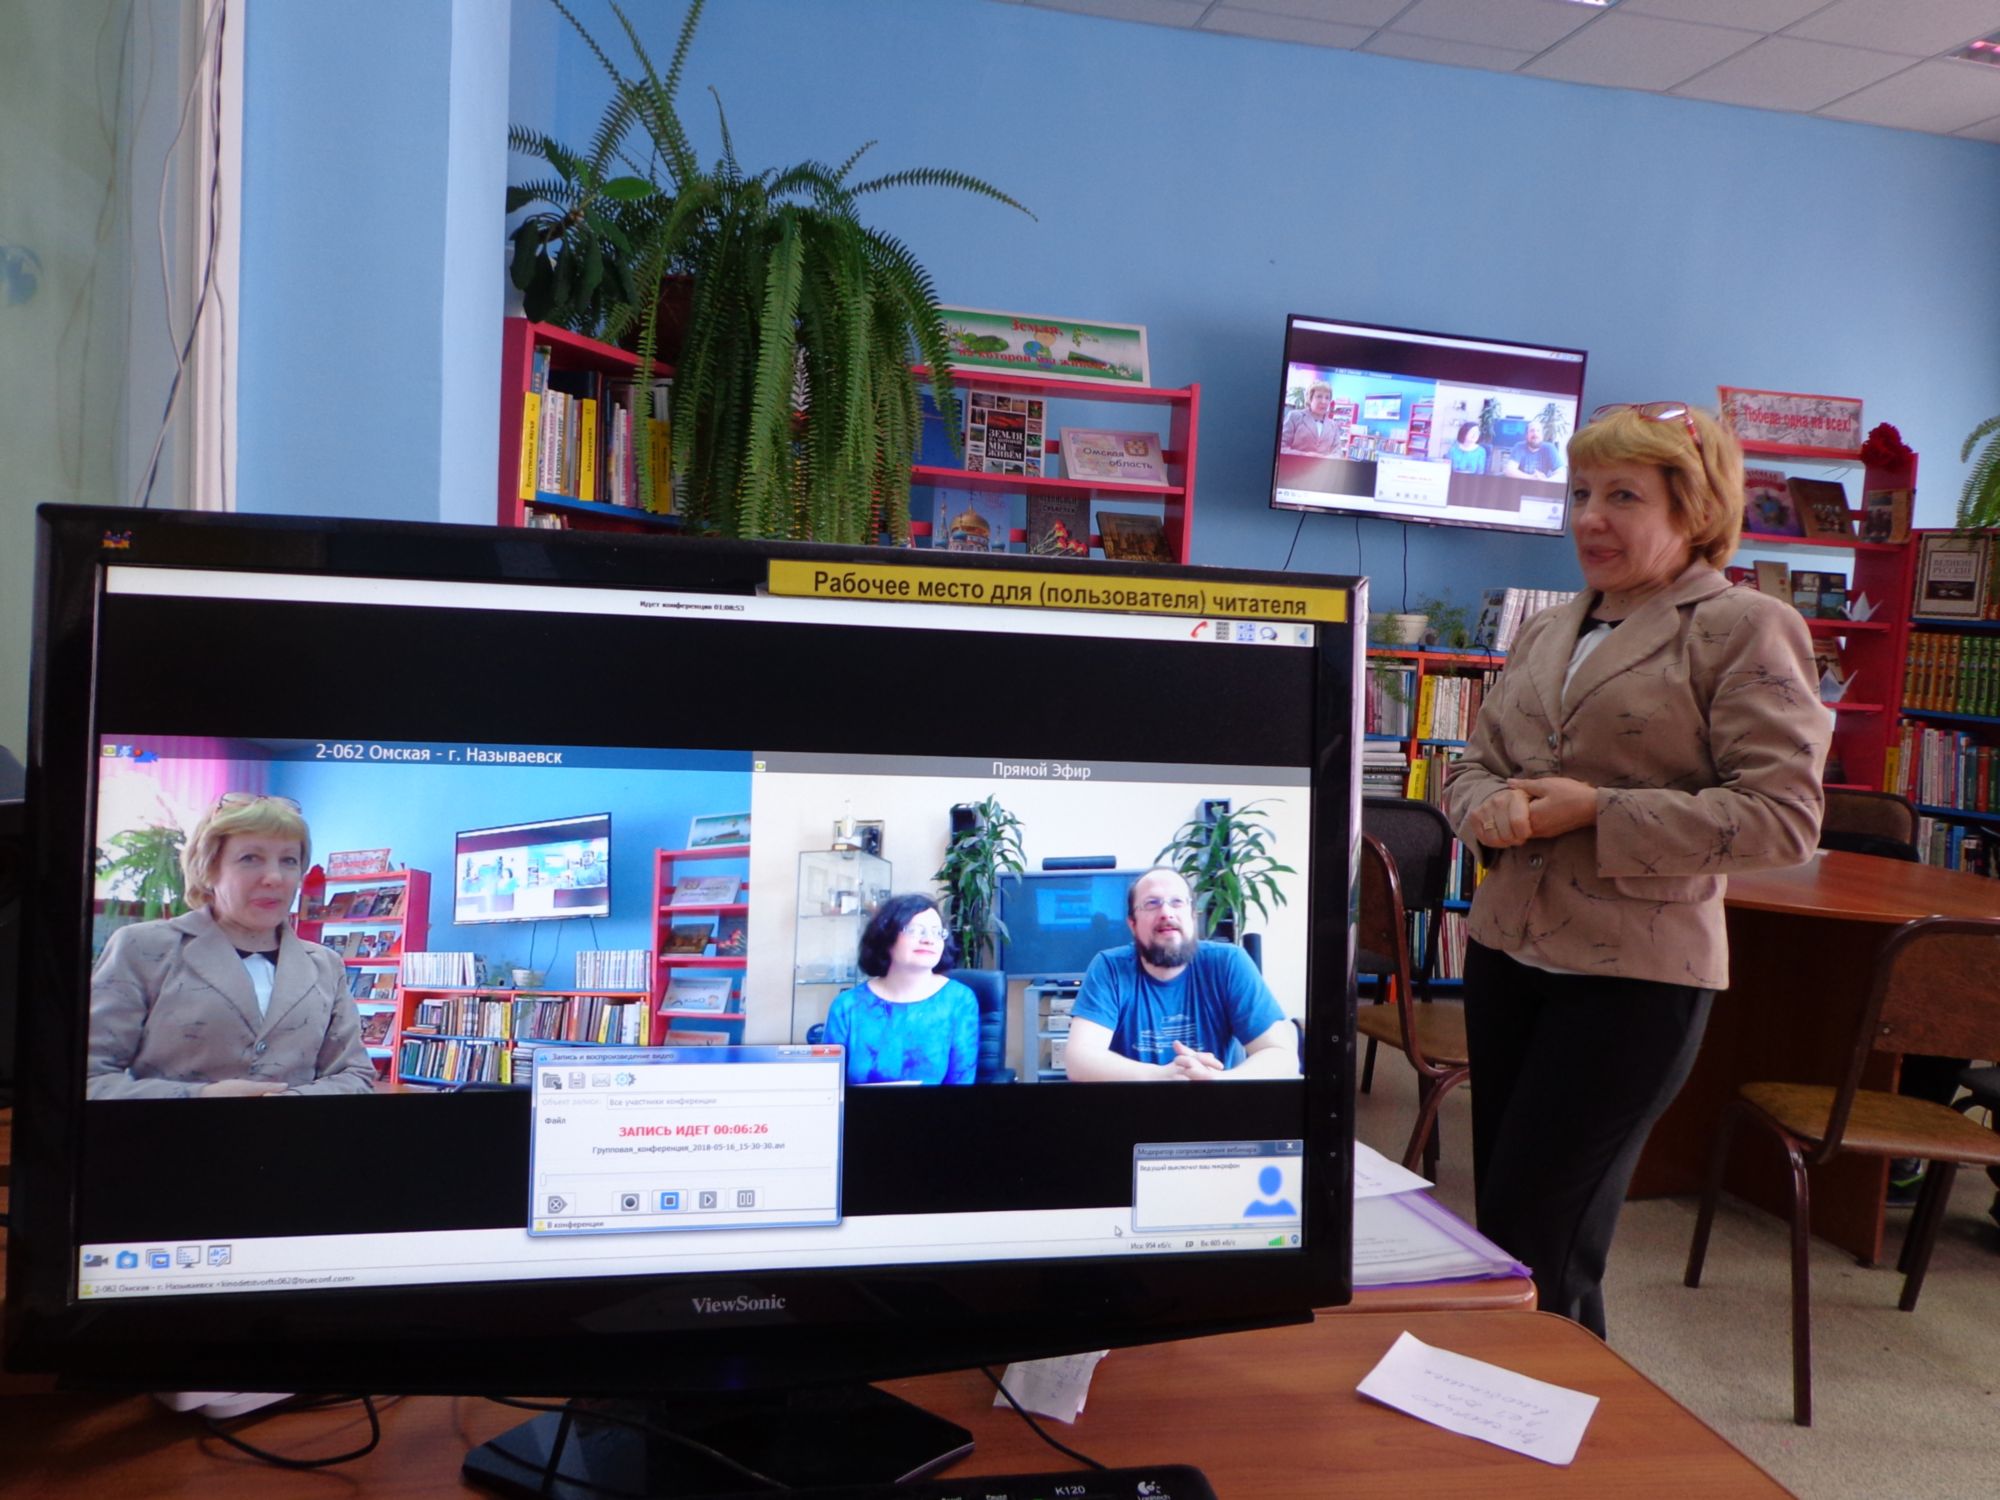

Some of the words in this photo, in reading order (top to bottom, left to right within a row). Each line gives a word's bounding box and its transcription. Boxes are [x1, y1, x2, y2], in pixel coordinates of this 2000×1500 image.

[1083, 446, 1126, 458] Омская
[1108, 459, 1154, 470] область
[814, 571, 911, 597] Рабочее
[917, 581, 984, 600] место
[990, 583, 1032, 604] для
[1039, 581, 1206, 614] (пользователя)
[1212, 594, 1306, 616] читателя
[315, 743, 364, 760] 2-062
[369, 744, 431, 761] Омская
[448, 749, 461, 762] г.
[466, 747, 563, 764] Называевск
[992, 760, 1048, 779] Прямой
[1051, 763, 1092, 781] Эфир
[544, 1116, 567, 1126] Файл
[619, 1126, 672, 1138] ЗАПИСЬ
[675, 1125, 710, 1137] ИДЕТ
[713, 1123, 769, 1136] 00:06:26
[691, 1293, 787, 1314] ViewSonic
[1054, 1485, 1087, 1497] K120
